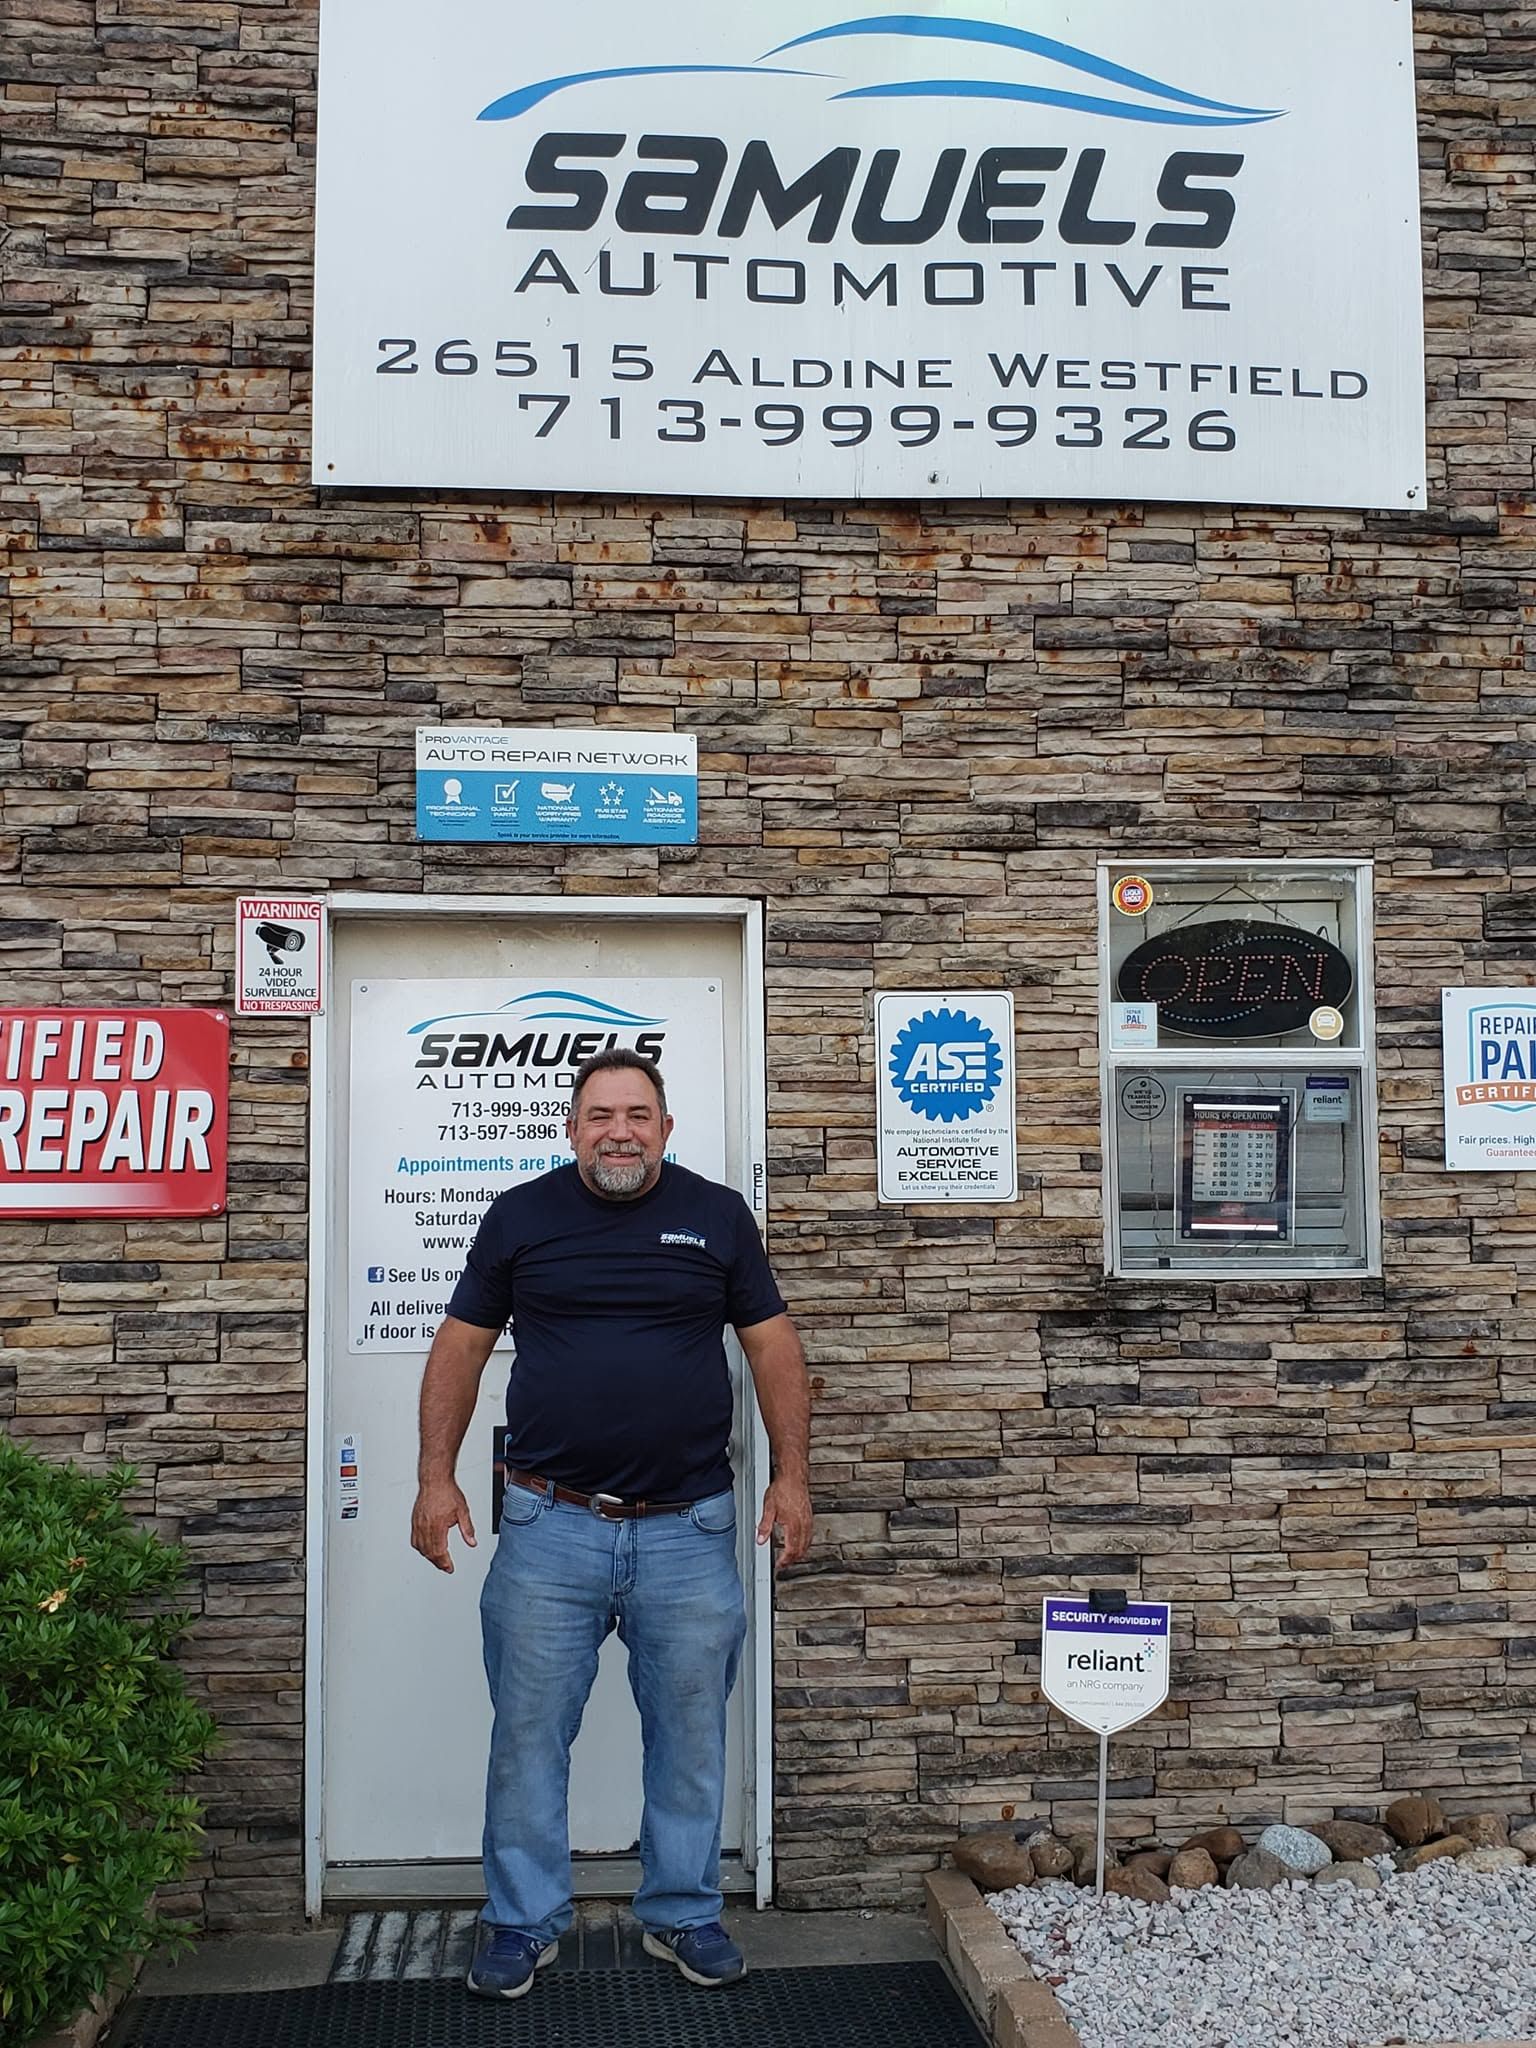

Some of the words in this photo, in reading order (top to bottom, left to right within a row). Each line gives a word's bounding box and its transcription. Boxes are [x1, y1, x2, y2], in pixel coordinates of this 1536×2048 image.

[514, 248, 1231, 312] AUTOMOTIVE
[376, 338, 655, 381] 26515
[692, 349, 953, 389] ALDINE
[987, 353, 1368, 400] WESTFIELD
[518, 393, 1237, 452] 713-999-9326
[425, 736, 508, 744] PROVANTAGE
[426, 750, 486, 762] AUTO
[492, 750, 572, 763] REPAIR
[578, 752, 688, 766] NETWORK
[242, 902, 320, 918] WARNING
[259, 968, 270, 976] 24
[273, 968, 302, 977] HOUR
[1140, 952, 1329, 1004] OPEN
[265, 978, 296, 987] VIDEO
[245, 988, 316, 997] SURVEILLANCE
[243, 1001, 258, 1010] NO
[260, 1001, 318, 1010] TRESPASSING
[1127, 1015, 1141, 1024] PAL
[1481, 1017, 1536, 1034] REPAI
[0, 1020, 164, 1081] IFIED
[904, 1042, 986, 1081] ASE
[910, 1082, 984, 1093] CERTIFIED
[1462, 1085, 1536, 1101] CERTIF
[1313, 1096, 1343, 1104] reliant
[452, 1100, 570, 1118] 713-999-9326
[1232, 1112, 1273, 1120] OPERATION
[0, 1089, 214, 1171] REPAIR
[438, 1124, 557, 1141] 713-597-5896
[1459, 1136, 1476, 1144] Fair
[1480, 1136, 1510, 1146] prices.
[1514, 1136, 1535, 1145] High
[897, 1146, 999, 1156] AUTOMOTIVE
[1486, 1148, 1536, 1157] Guarantee
[398, 1156, 513, 1176] Appointments
[519, 1158, 545, 1170] are
[916, 1159, 981, 1168] SERVICE
[899, 1171, 998, 1181] EXCELLENCE
[753, 1163, 763, 1211] BELL
[384, 1189, 436, 1204] Hours:
[388, 1268, 416, 1282] See
[421, 1268, 440, 1282] Us
[445, 1270, 463, 1282] on
[370, 1301, 390, 1316] All
[364, 1324, 376, 1340] If
[380, 1324, 416, 1339] door
[422, 1323, 435, 1338] is
[1052, 1611, 1107, 1623] SECURITY
[1109, 1616, 1150, 1625] PROVIDED
[1152, 1618, 1162, 1626] BY
[1068, 1649, 1144, 1672] reliant
[1080, 1680, 1101, 1689] NRG
[1103, 1683, 1144, 1693] company
